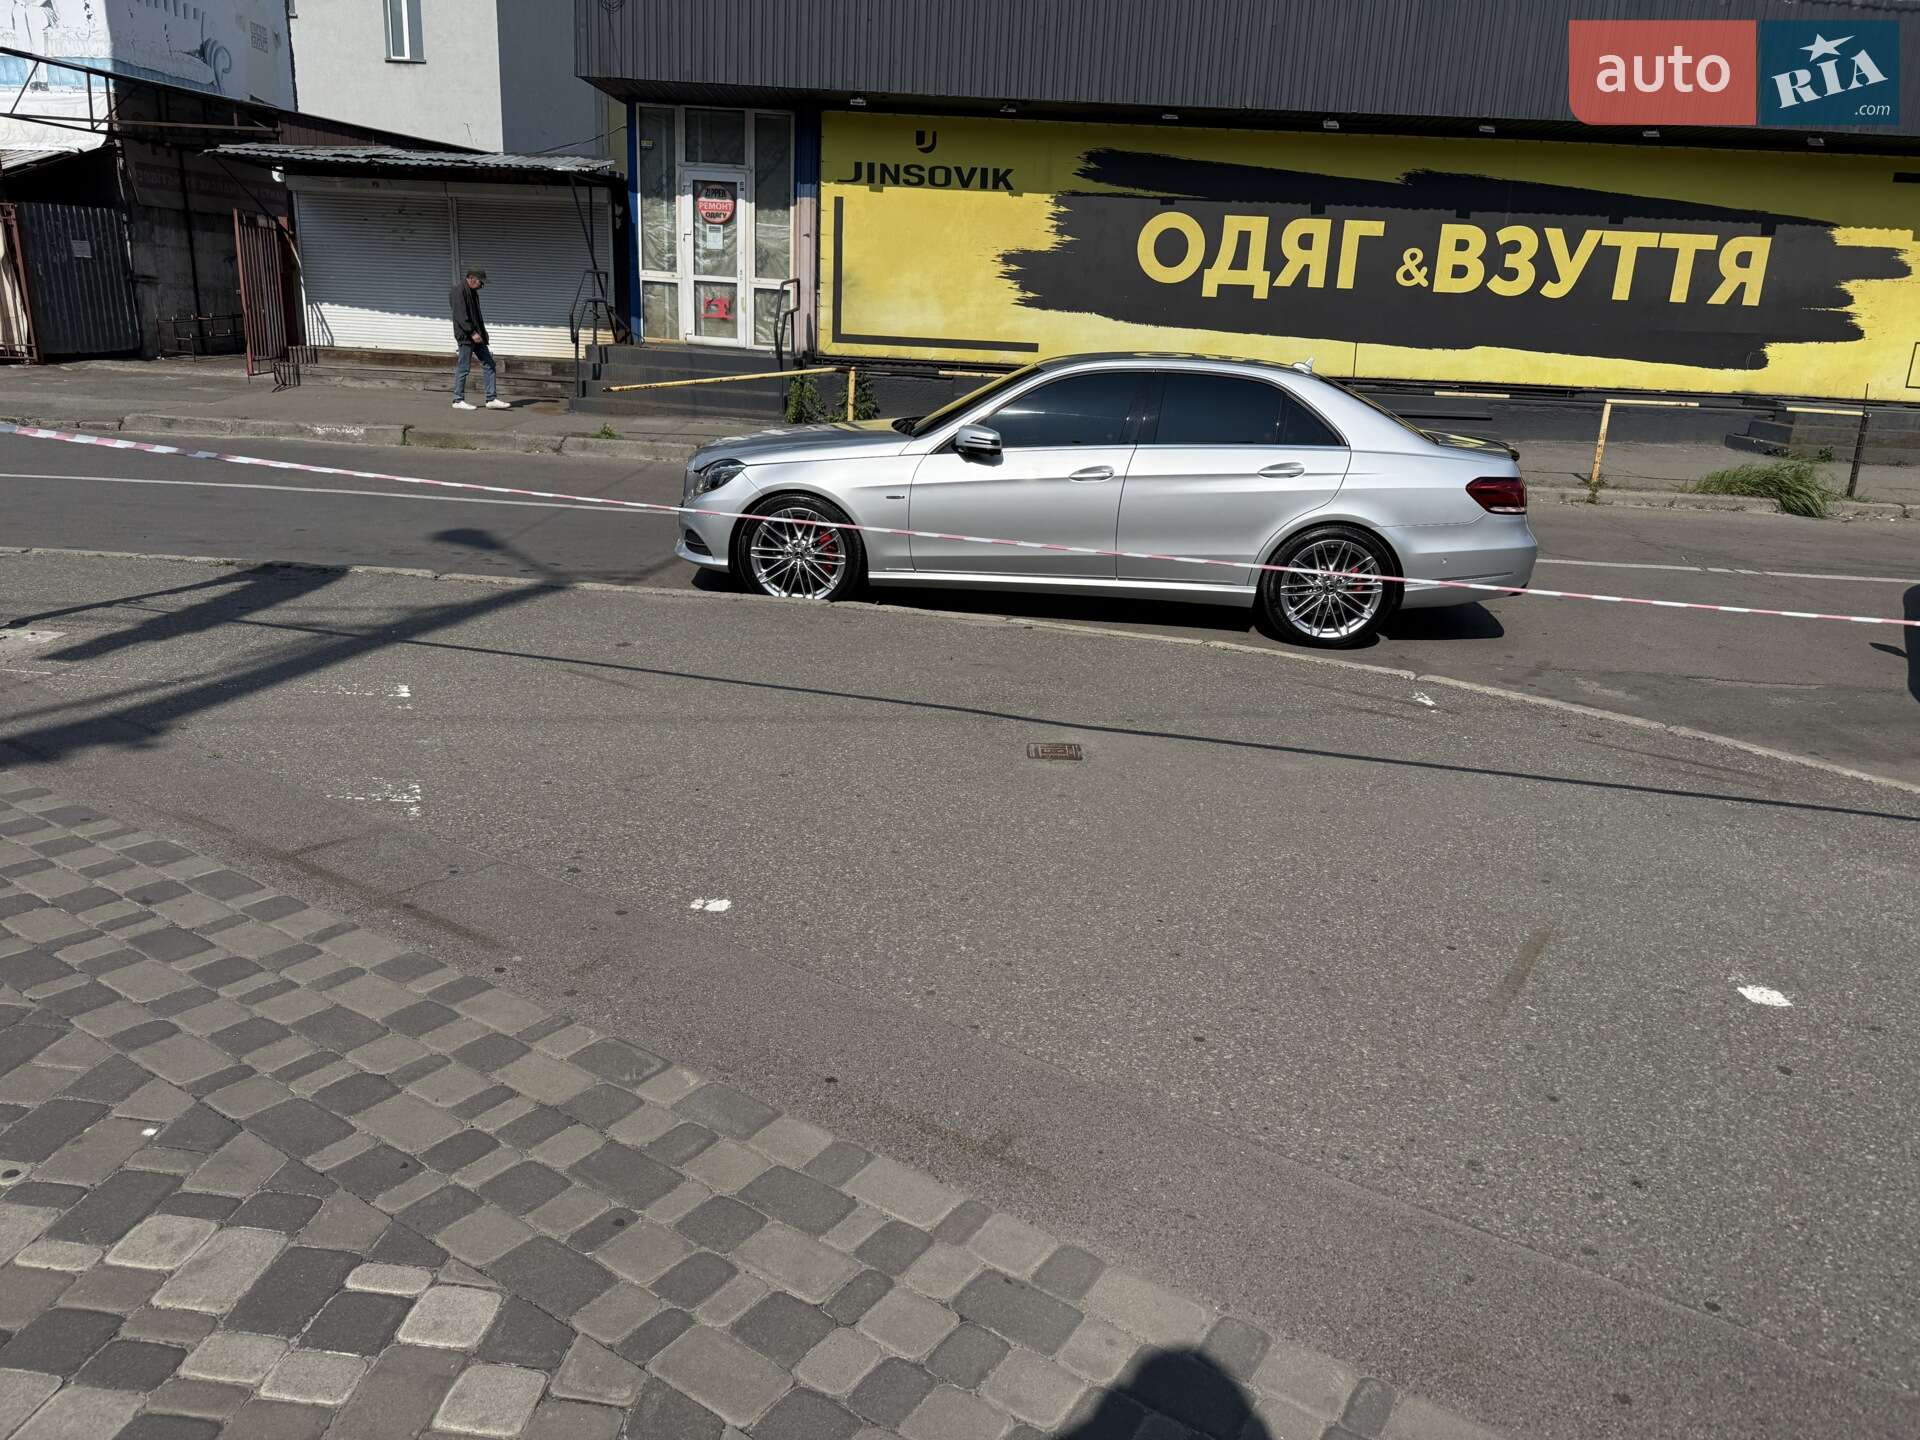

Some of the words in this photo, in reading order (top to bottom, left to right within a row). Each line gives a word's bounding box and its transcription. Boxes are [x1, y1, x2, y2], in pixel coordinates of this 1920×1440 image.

[837, 161, 1015, 191] JINSOVIK
[699, 201, 733, 211] РЕМОНТ
[1137, 211, 1385, 299] ОДЯГ
